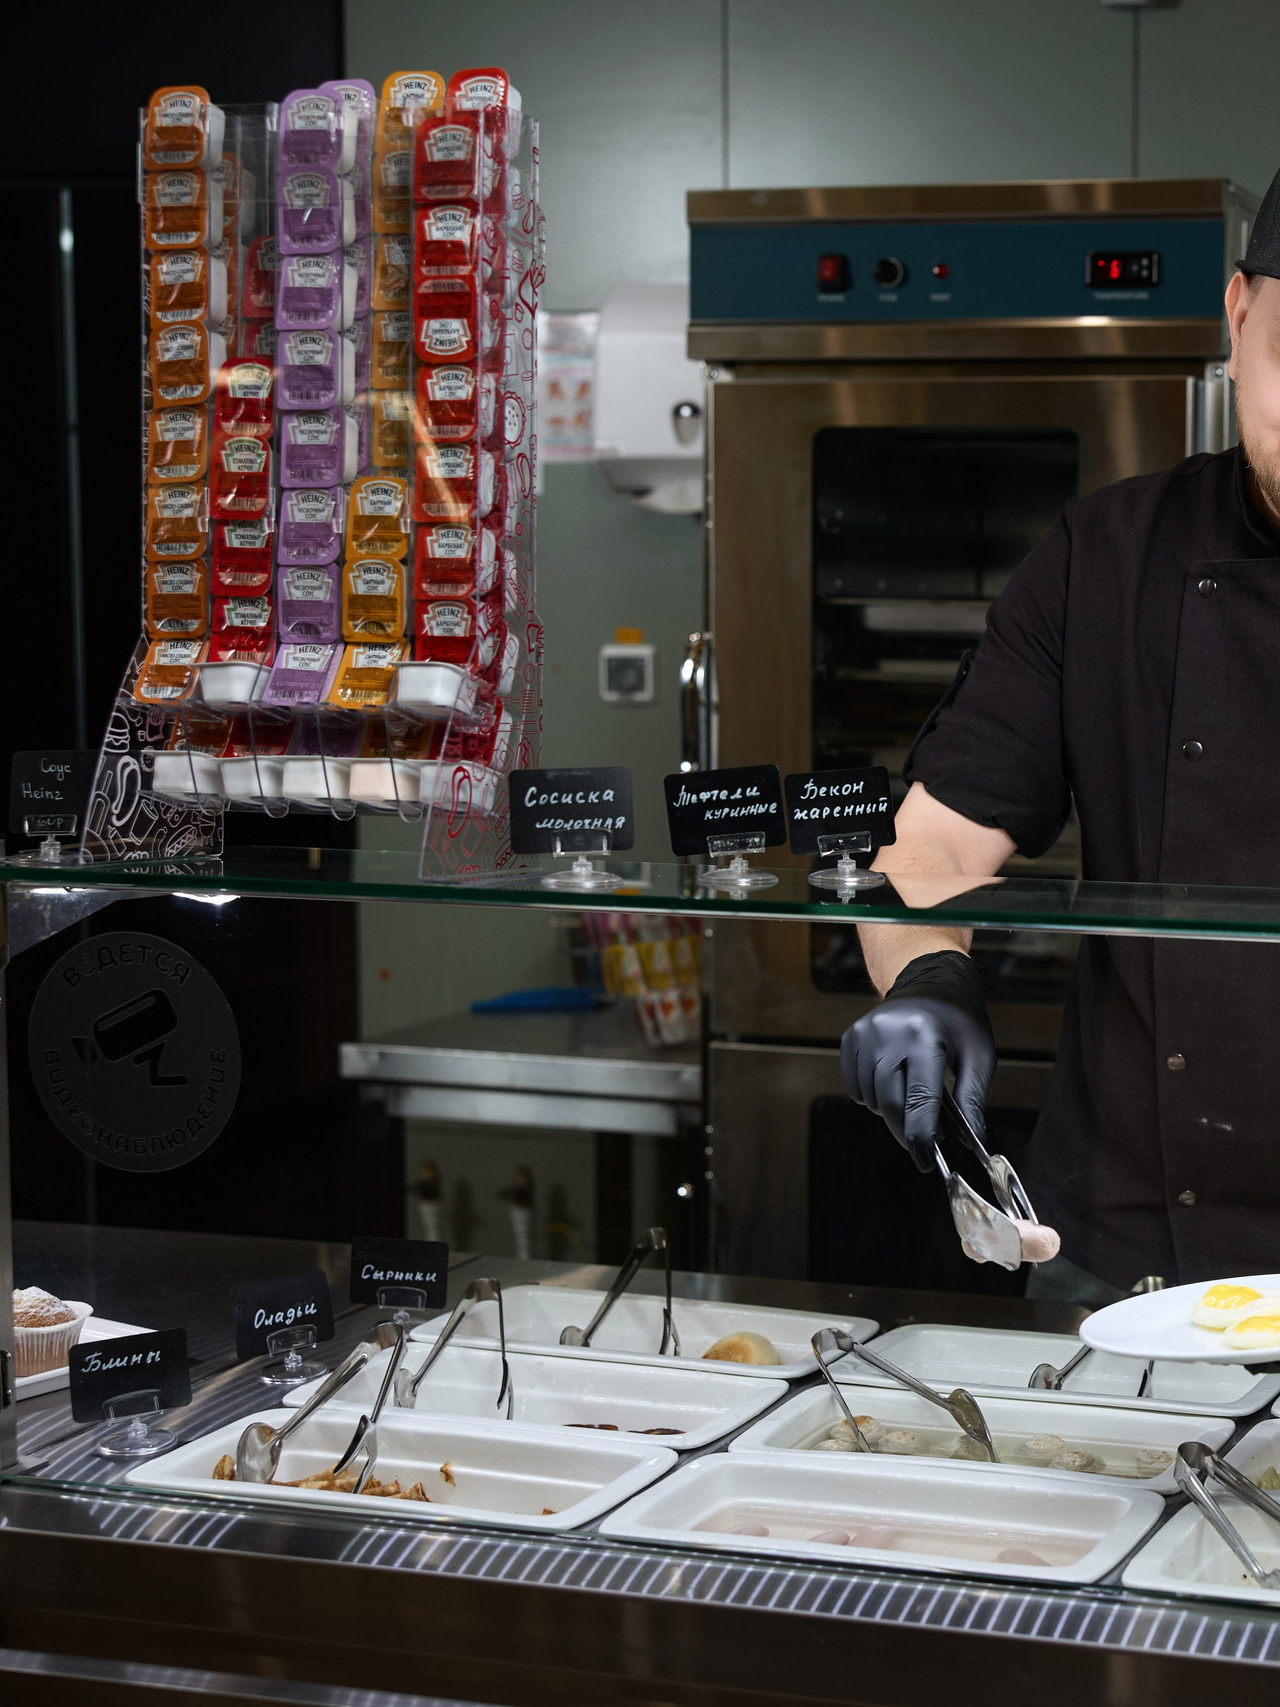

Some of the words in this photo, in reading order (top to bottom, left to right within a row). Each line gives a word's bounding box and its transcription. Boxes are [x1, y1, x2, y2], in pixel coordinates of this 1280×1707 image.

[404, 81, 427, 90] HEINZ
[469, 85, 493, 93] HEINZ
[169, 99, 193, 109] HEINZ
[302, 101, 326, 112] HEINZ
[438, 132, 463, 142] HEINZ
[166, 178, 190, 188] HEINZ
[297, 179, 320, 190] HEINZ
[437, 212, 463, 223] HEINZ
[170, 256, 193, 265] HEINZ
[302, 260, 326, 269] HEINZ
[168, 333, 191, 342] HEINZ
[299, 336, 322, 346] HEINZ
[433, 338, 458, 348] HEINZ
[441, 372, 465, 382] HEINZ
[169, 413, 193, 423] HEINZ
[302, 416, 326, 426] HEINZ
[234, 444, 257, 454] HEINZ
[439, 449, 463, 459] HEINZ
[167, 490, 191, 500] HEINZ
[370, 487, 394, 497] HEINZ
[301, 495, 325, 504] HEINZ
[236, 519, 260, 530] HEINZ
[441, 531, 464, 540] HEINZ
[167, 566, 190, 576] HEINZ
[362, 566, 387, 577] HEINZ
[296, 571, 321, 582] HEINZ
[237, 599, 261, 608] HEINZ
[437, 607, 460, 617] HEINZ
[170, 641, 192, 651] HEINZ
[299, 645, 323, 655] HEINZ
[368, 644, 392, 652] HEINZ
[41, 757, 72, 781] Соус
[22, 782, 63, 800] Heinz
[800, 778, 865, 800] Бекон
[524, 786, 615, 808] Сосиска
[672, 784, 761, 808] Тефтели
[704, 800, 778, 821] куринные
[793, 797, 889, 821] жаренный
[535, 816, 626, 830] молочная
[62, 943, 193, 990] ВЕДЕТСЯ
[44, 1048, 227, 1156] ВИДЕОНАБЛЮДЕНИЕ
[361, 1263, 438, 1283] Сырники
[254, 1302, 318, 1330] Оладьи
[80, 1349, 163, 1373] Блины
